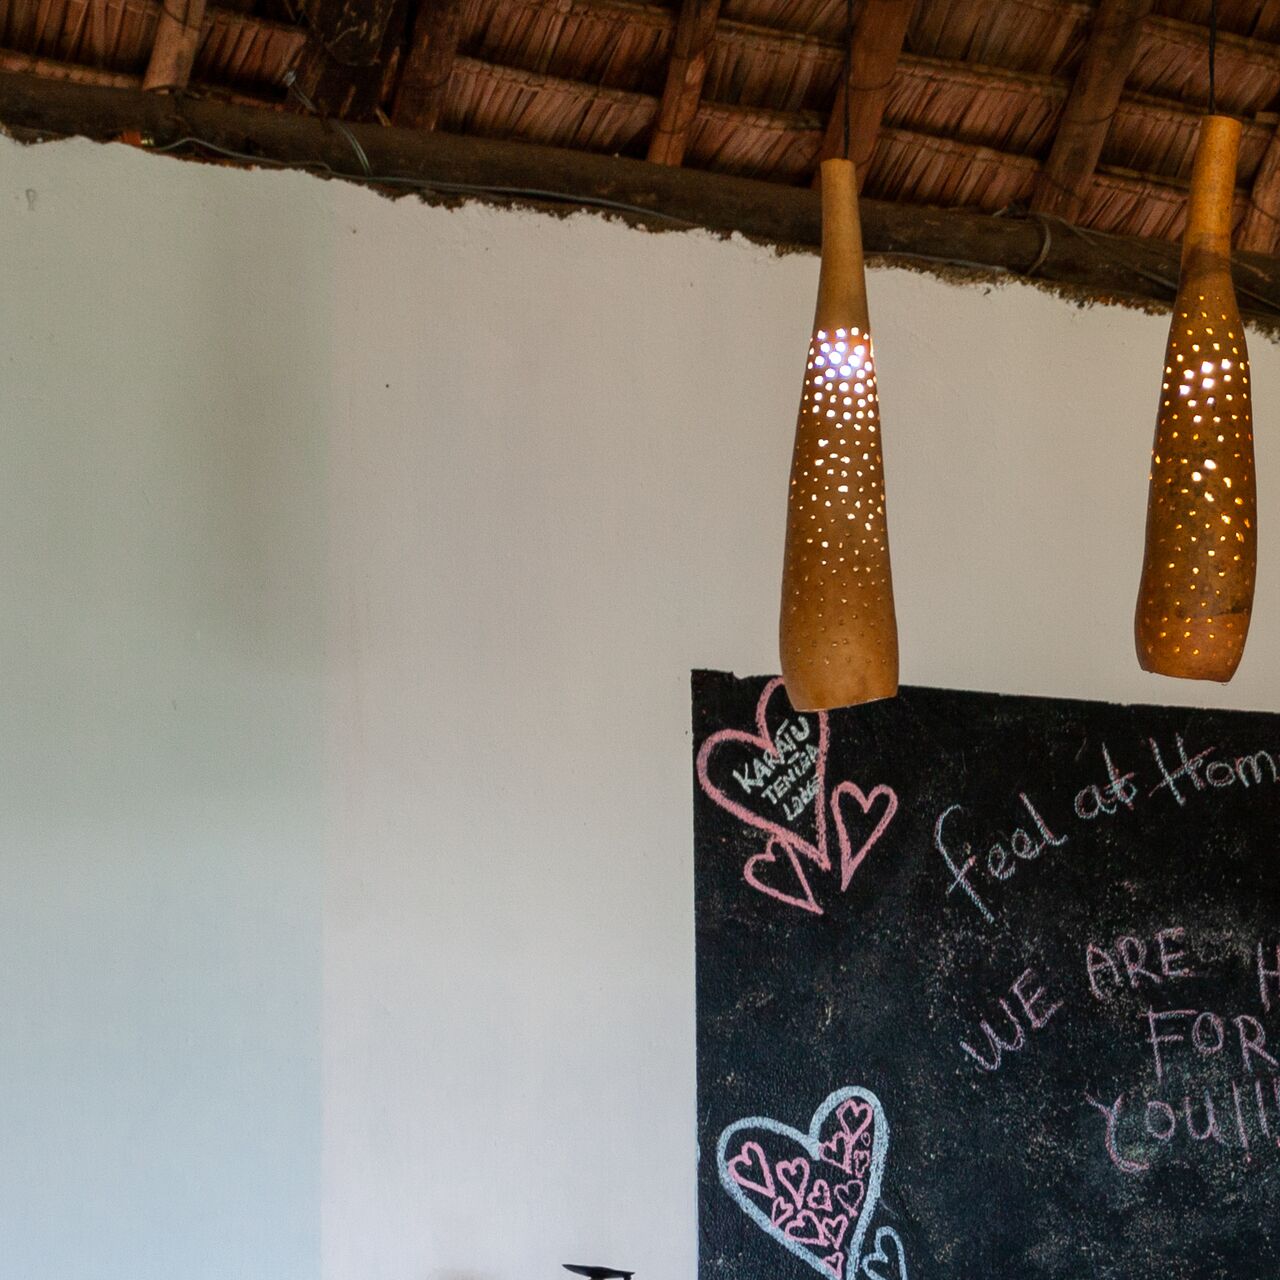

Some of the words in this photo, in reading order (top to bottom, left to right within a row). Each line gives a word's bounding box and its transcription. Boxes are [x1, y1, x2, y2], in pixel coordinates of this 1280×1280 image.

[732, 715, 811, 794] KARATU
[1074, 741, 1138, 819] at
[960, 967, 1064, 1071] WE
[1086, 927, 1198, 999] ARE
[1136, 1004, 1279, 1084] FOR
